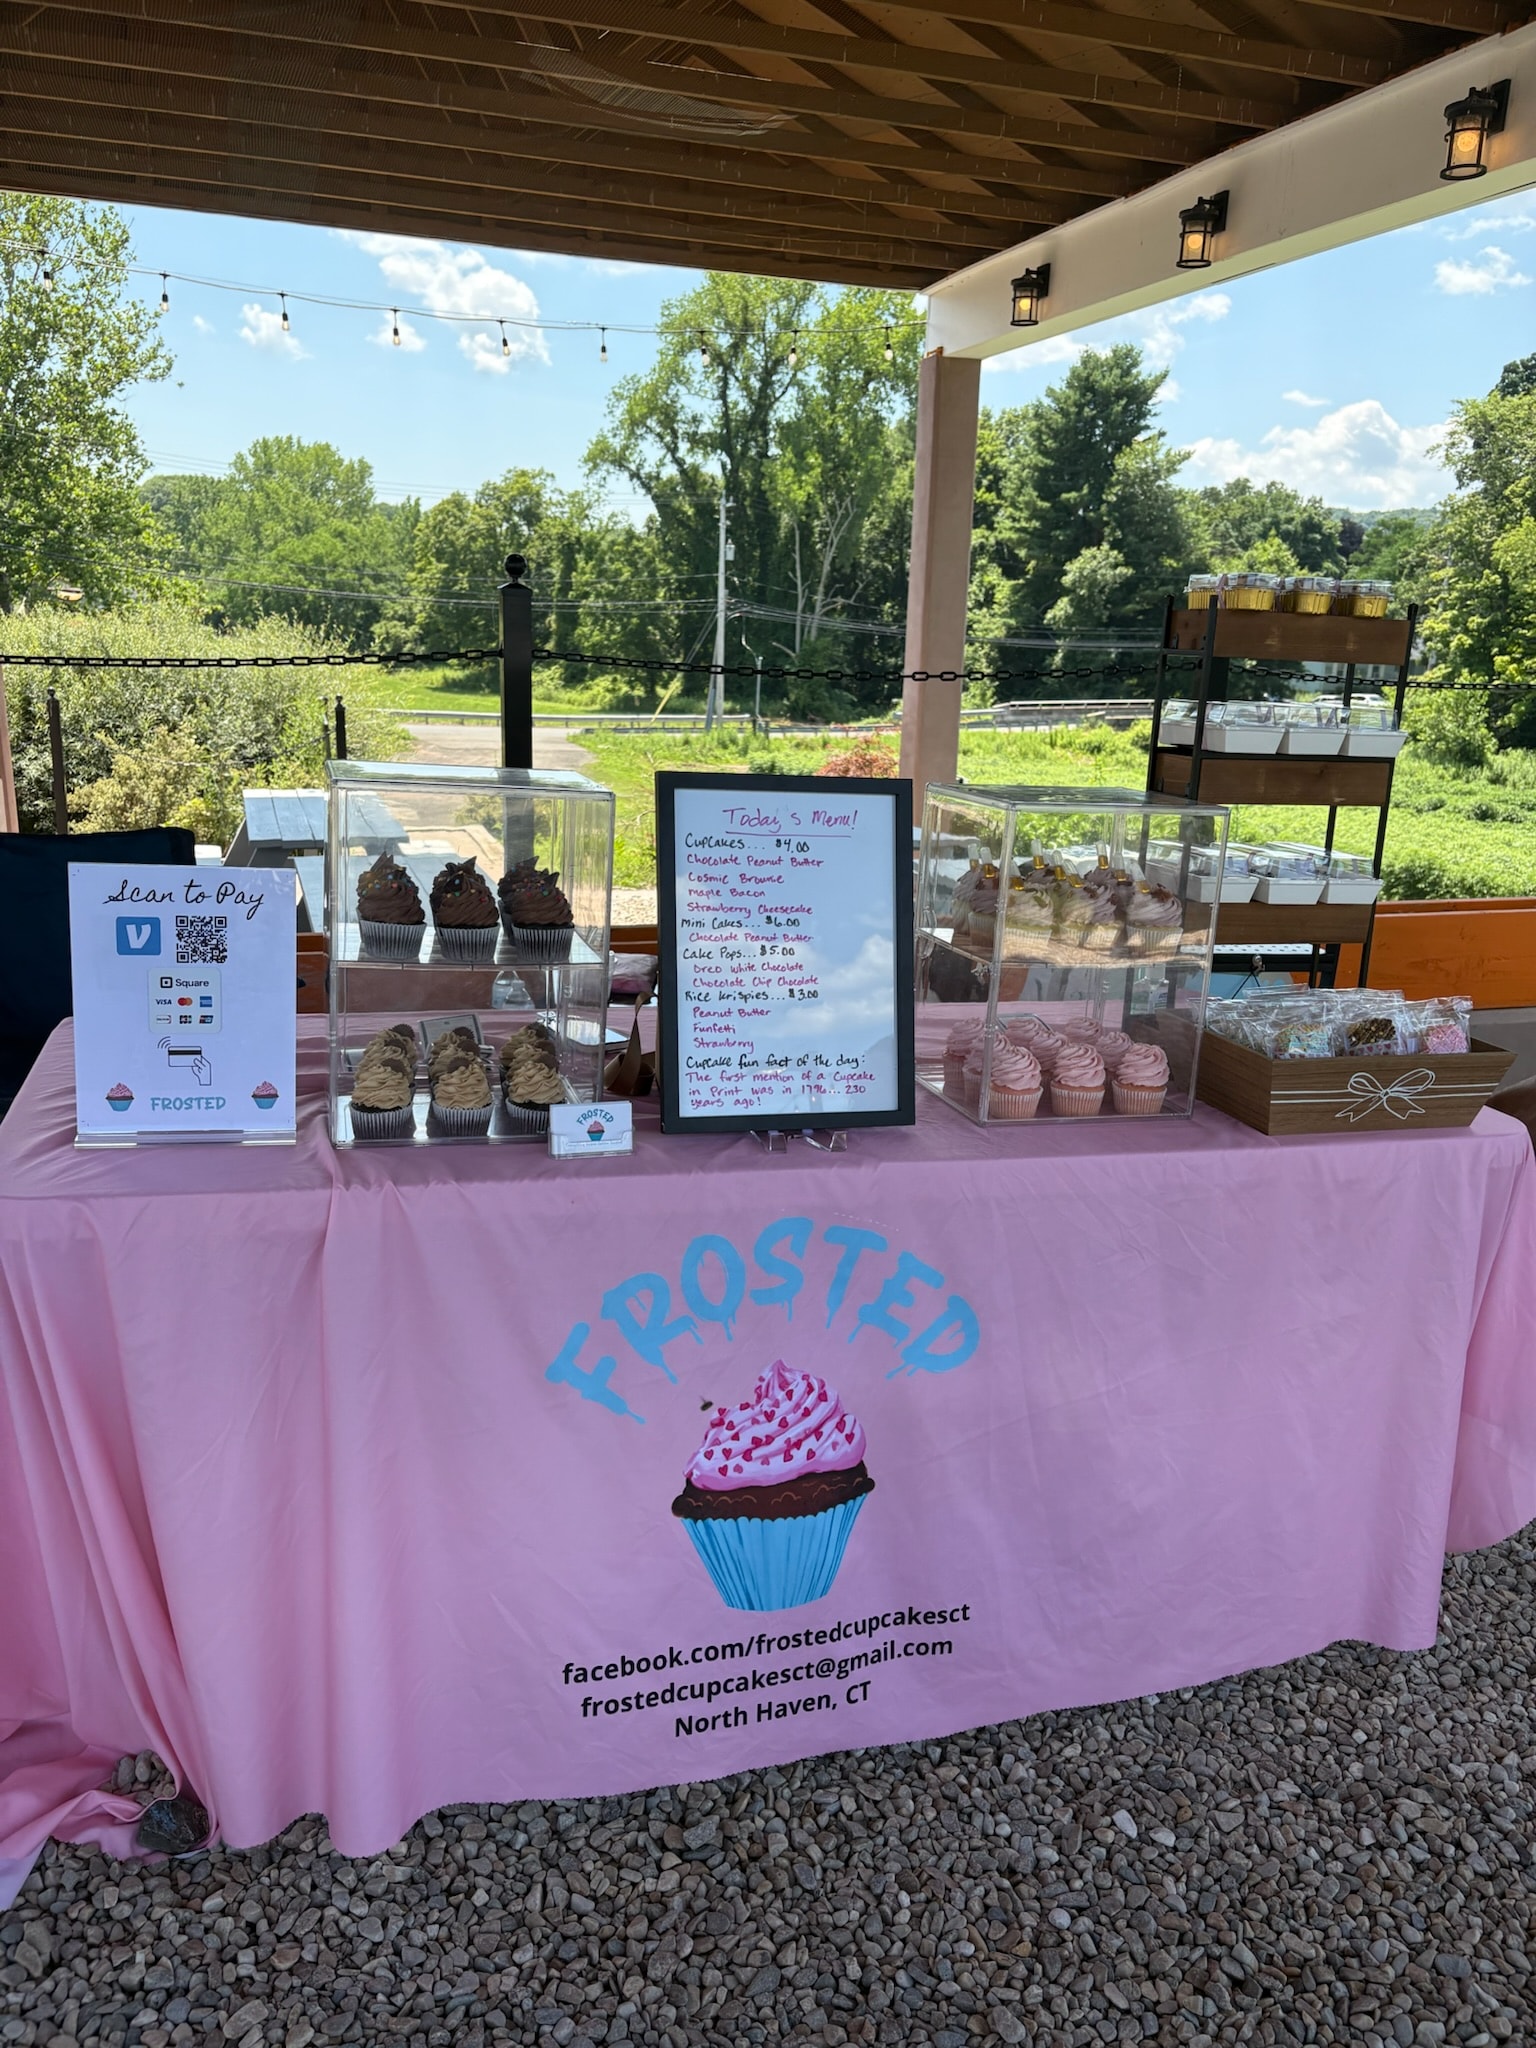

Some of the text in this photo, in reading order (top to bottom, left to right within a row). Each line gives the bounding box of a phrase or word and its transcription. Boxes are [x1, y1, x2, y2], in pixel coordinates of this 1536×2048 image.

[812, 809, 859, 830] Menu!
[775, 838, 810, 854] $4.00
[687, 854, 824, 867] Chocolate Peanut Butter
[688, 872, 729, 884] Cosmic
[102, 878, 264, 921] Scan to Pay
[729, 888, 766, 897] Bacon
[687, 902, 813, 919] Strawberry Cheesecake
[765, 915, 801, 928] $6.00
[689, 932, 814, 942] Chocolate Peanut Butter
[683, 948, 714, 960] Cake
[760, 944, 796, 957] $5.00
[693, 964, 723, 974] Oreo
[761, 962, 804, 972] Chocolate
[175, 978, 210, 989] Square
[693, 975, 819, 988] Chocolate Chip Chocolate
[155, 998, 172, 1006] VISA
[685, 991, 711, 1002] Rice
[693, 1006, 771, 1019] Peanut Butter
[693, 1022, 736, 1034] Funfetti
[693, 1037, 755, 1055] Strawberry
[686, 1053, 865, 1070] Cupcake fun fact of the day:
[685, 1071, 712, 1083] The
[719, 1069, 747, 1082] first
[752, 1072, 794, 1083] mention
[801, 1070, 812, 1081] of
[688, 1088, 701, 1096] in
[751, 1086, 774, 1095] was
[782, 1086, 792, 1095] in
[845, 1085, 866, 1094] 230
[150, 1096, 226, 1111] FROSTED
[691, 1096, 761, 1110] years ago!
[575, 1108, 614, 1125] FROSTED
[544, 1216, 981, 1425] FROSTED
[562, 1603, 971, 1685] facebook.com/frostedcupcakesct
[580, 1639, 954, 1718] frostedcupcakesct@gmail.com
[674, 1680, 873, 1738] North Haven, CT
